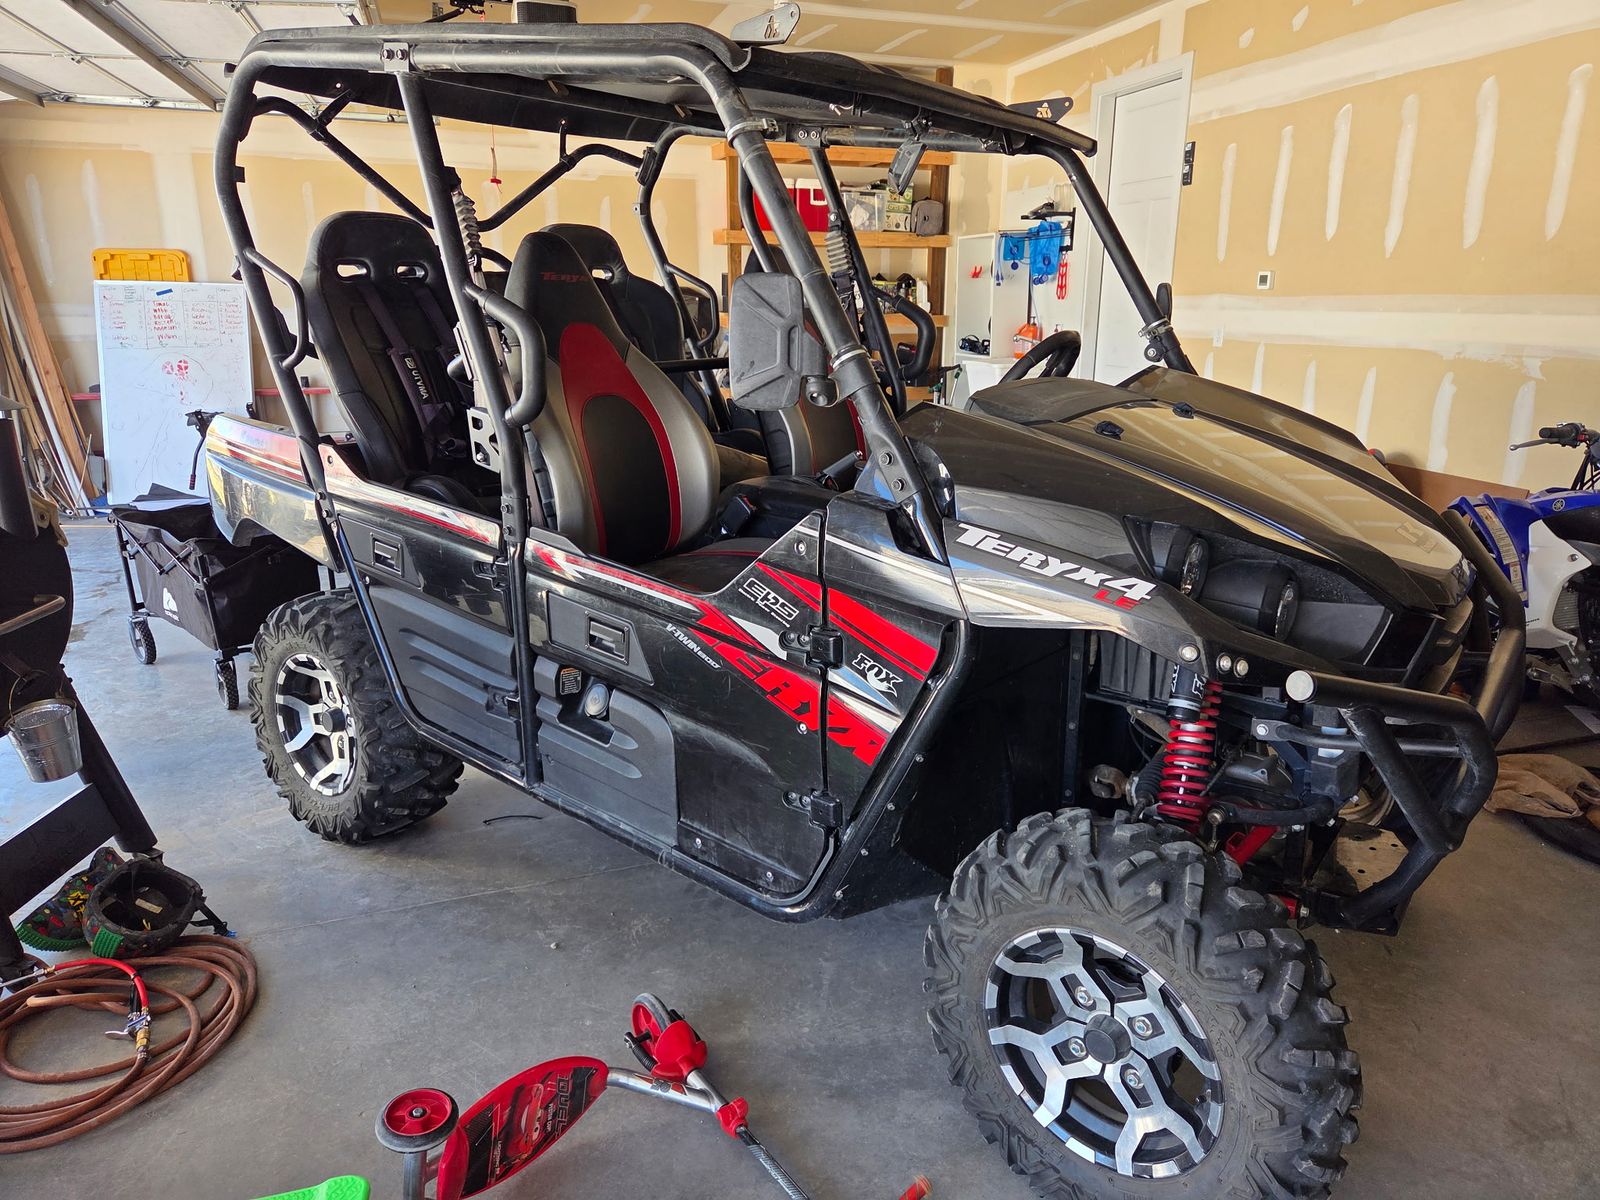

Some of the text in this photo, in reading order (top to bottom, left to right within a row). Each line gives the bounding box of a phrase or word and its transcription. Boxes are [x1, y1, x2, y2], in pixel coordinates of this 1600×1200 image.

[412, 370, 429, 399] UTVMA
[955, 522, 1158, 601] TERYX4
[743, 577, 800, 621] EPS
[1092, 588, 1142, 610] LE
[851, 652, 904, 698] FOX
